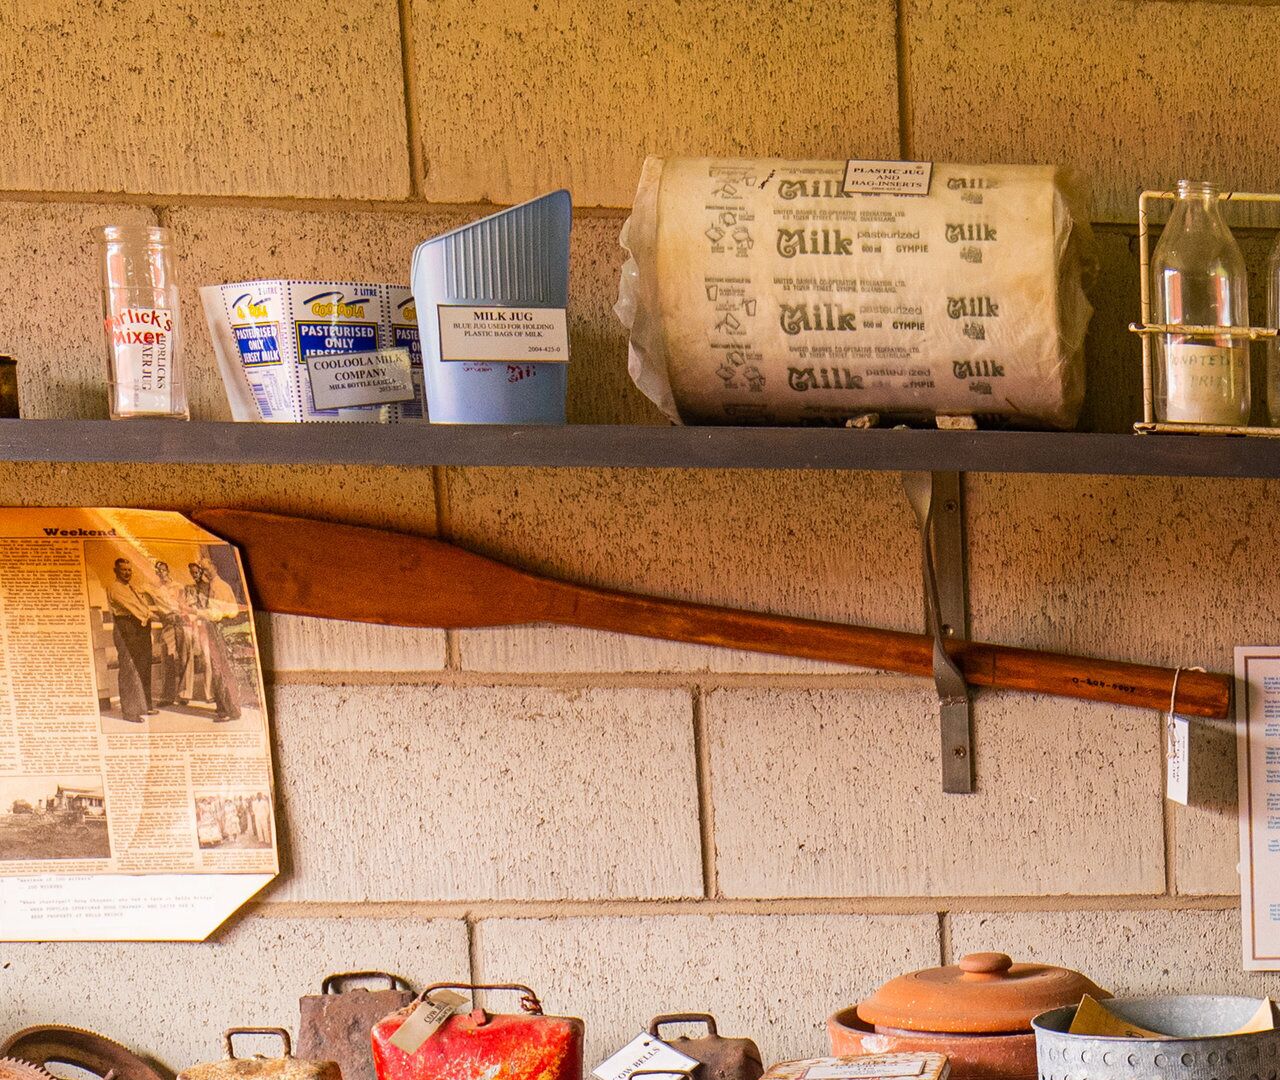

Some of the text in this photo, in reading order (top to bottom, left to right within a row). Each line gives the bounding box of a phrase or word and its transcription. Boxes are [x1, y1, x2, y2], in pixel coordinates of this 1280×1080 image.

[857, 230, 920, 239] pasteurized
[945, 223, 998, 243] Milk
[777, 229, 853, 258] Milk
[895, 245, 928, 253] GYMPIE
[354, 288, 358, 296] 2
[311, 302, 365, 319] COOOOLA
[859, 304, 922, 315] pasteurized
[946, 297, 999, 319] Milk
[474, 311, 533, 321] MILK JUG
[780, 303, 856, 335] Milk
[236, 327, 277, 339] PASTEURISED
[301, 325, 374, 338] PASTEURISED
[892, 322, 925, 331] GYMPIE
[112, 328, 164, 345] Mixer
[248, 340, 264, 351] ONLY
[324, 338, 354, 349] ONLY
[243, 350, 281, 363] JERSEY MILK
[313, 355, 373, 370] COOLOOLA
[334, 368, 387, 382] COMPANY
[865, 368, 931, 376] pasteuized
[953, 360, 1005, 379] Milk
[787, 367, 864, 391] Milk
[43, 528, 117, 536] Weekend
[633, 1048, 660, 1068] BELLS
